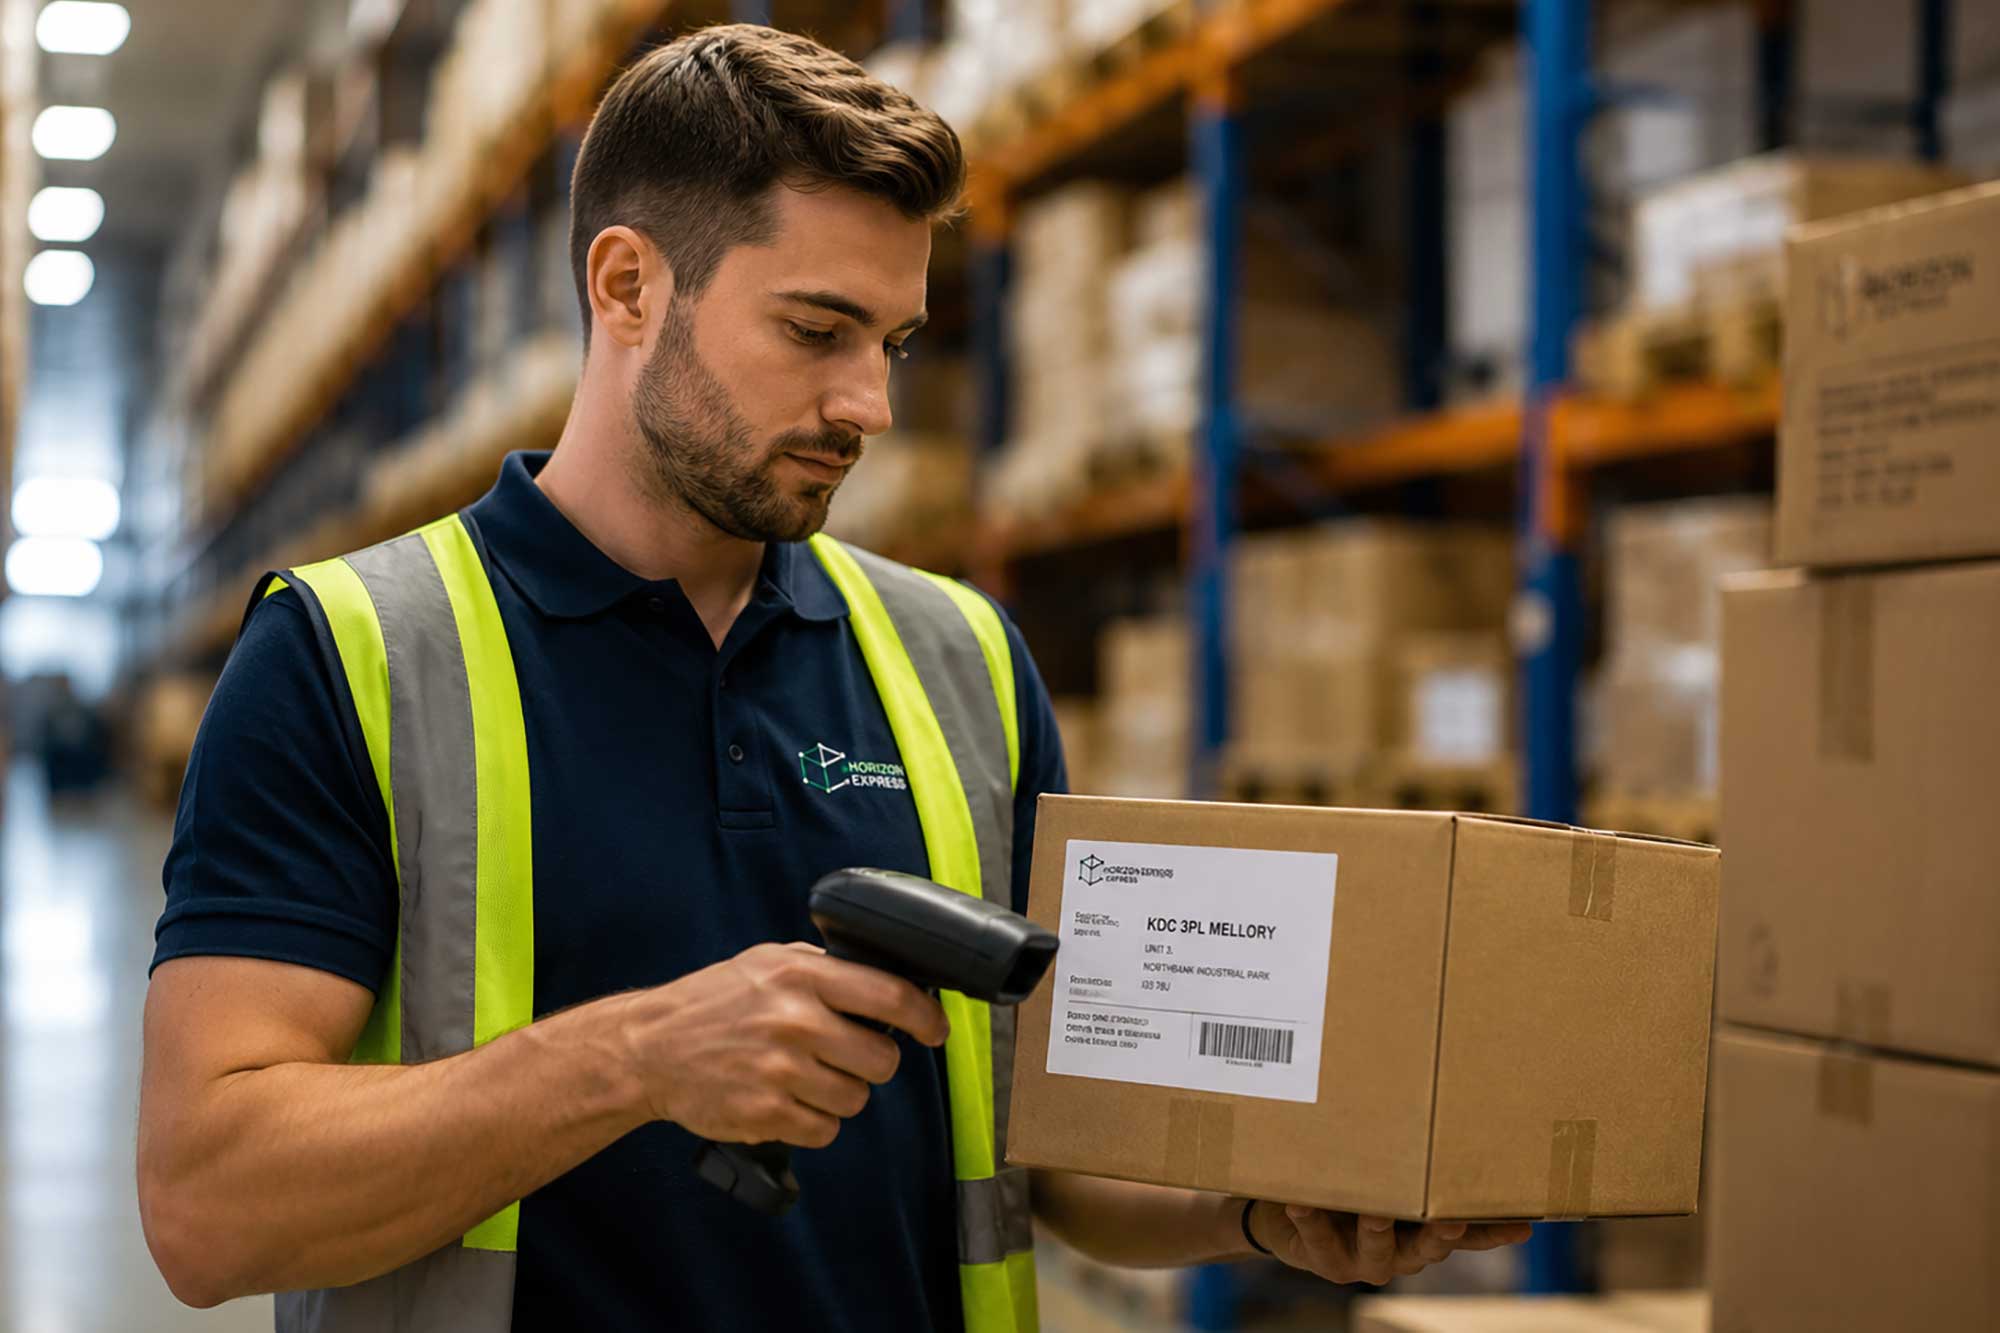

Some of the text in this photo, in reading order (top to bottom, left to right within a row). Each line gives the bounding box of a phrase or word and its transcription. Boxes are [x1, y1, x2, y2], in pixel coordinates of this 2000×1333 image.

[848, 761, 904, 776] HORIZON
[851, 775, 906, 790] EXPRESS
[1147, 917, 1276, 940] KDC 3PL MELLORY
[1197, 966, 1245, 979] INDUSTRIAL
[1247, 970, 1270, 981] PARK
